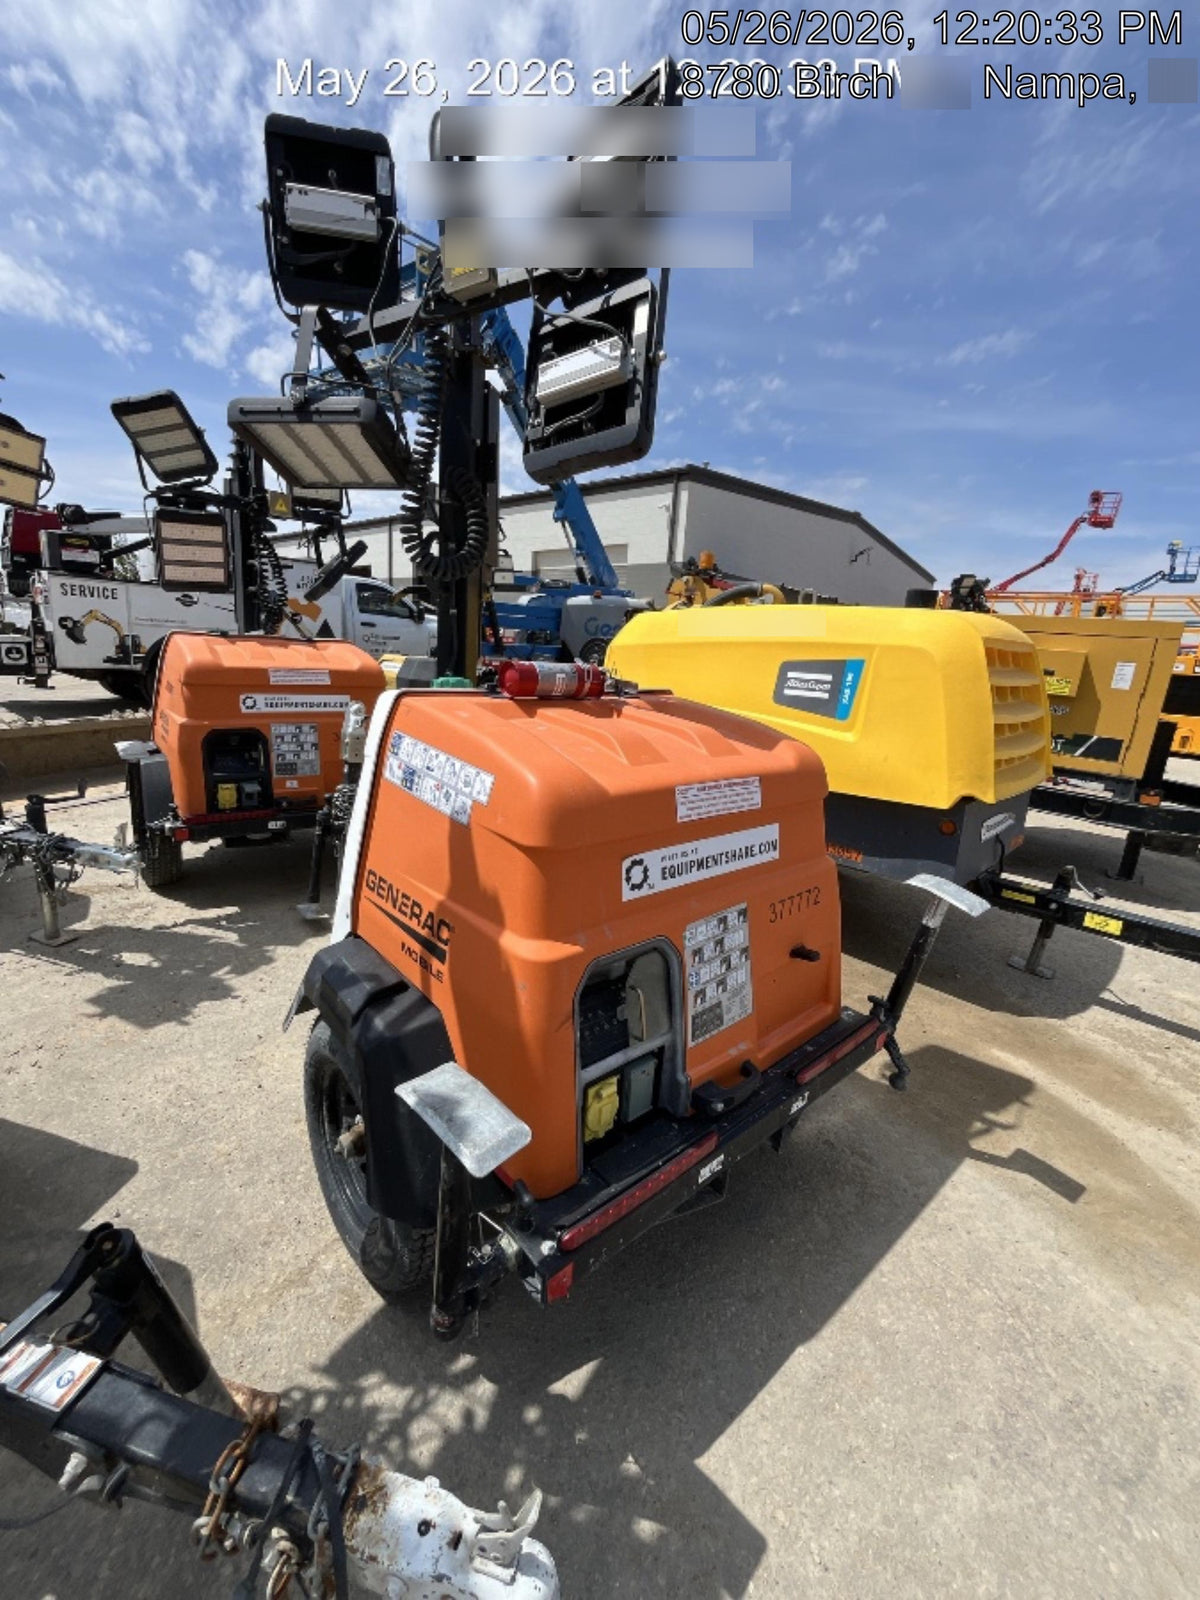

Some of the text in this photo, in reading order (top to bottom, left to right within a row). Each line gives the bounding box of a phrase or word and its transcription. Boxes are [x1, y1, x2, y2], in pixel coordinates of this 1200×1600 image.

[60, 582, 118, 600] SERVICE
[661, 838, 778, 881] EQUIPMENTSHARE.COM
[365, 868, 452, 947] GENERAC
[769, 886, 821, 924] 377772
[401, 942, 444, 983] MOBILE
